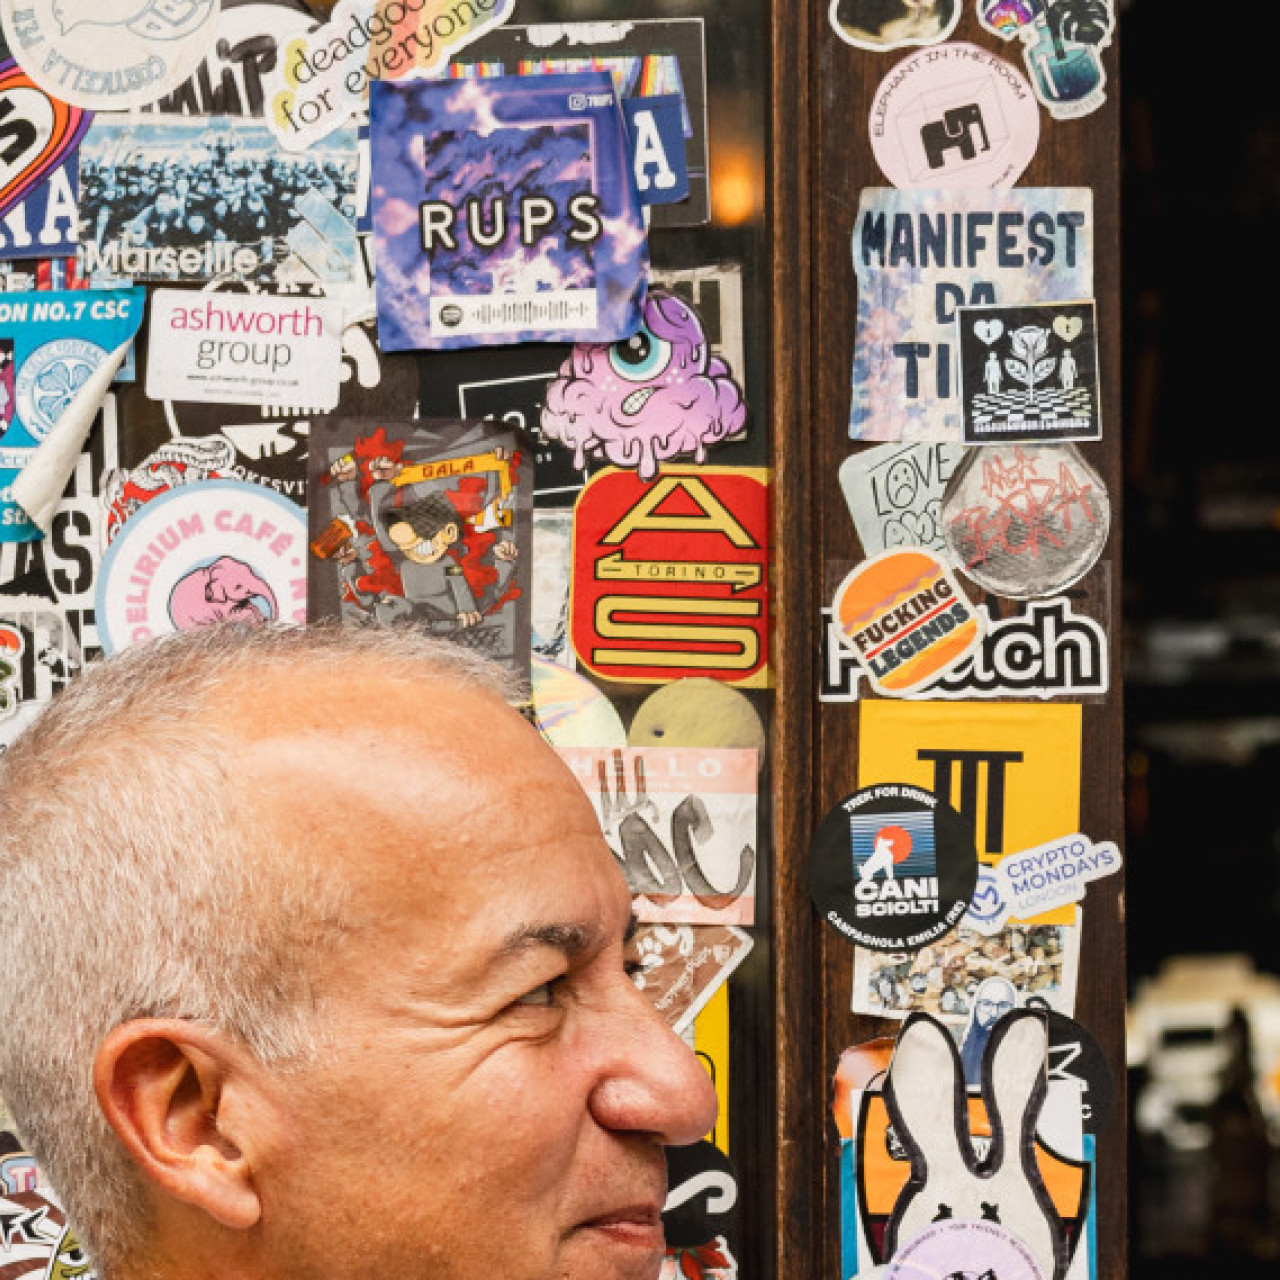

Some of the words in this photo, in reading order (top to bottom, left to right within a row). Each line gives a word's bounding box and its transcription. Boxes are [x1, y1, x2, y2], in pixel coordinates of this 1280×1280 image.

[281, 88, 333, 133] for
[422, 195, 601, 249] RUPS
[861, 211, 1085, 269] MANIFEST
[86, 240, 259, 273] Marseille
[33, 301, 86, 323] NO.7
[90, 299, 131, 321] CSC
[171, 300, 323, 338] ashworth
[197, 340, 292, 373] group
[422, 459, 475, 478] GALA
[126, 513, 205, 644] DELIRIUM
[634, 565, 726, 579] TORINO
[852, 578, 953, 650] FUCKING
[868, 602, 971, 679] LEGENDS
[570, 755, 723, 778] HELLO
[1007, 841, 1086, 878] CRYPTO
[1012, 850, 1115, 895] MONDAYS
[854, 876, 939, 901] CANI
[855, 901, 939, 918] SCIOLTI
